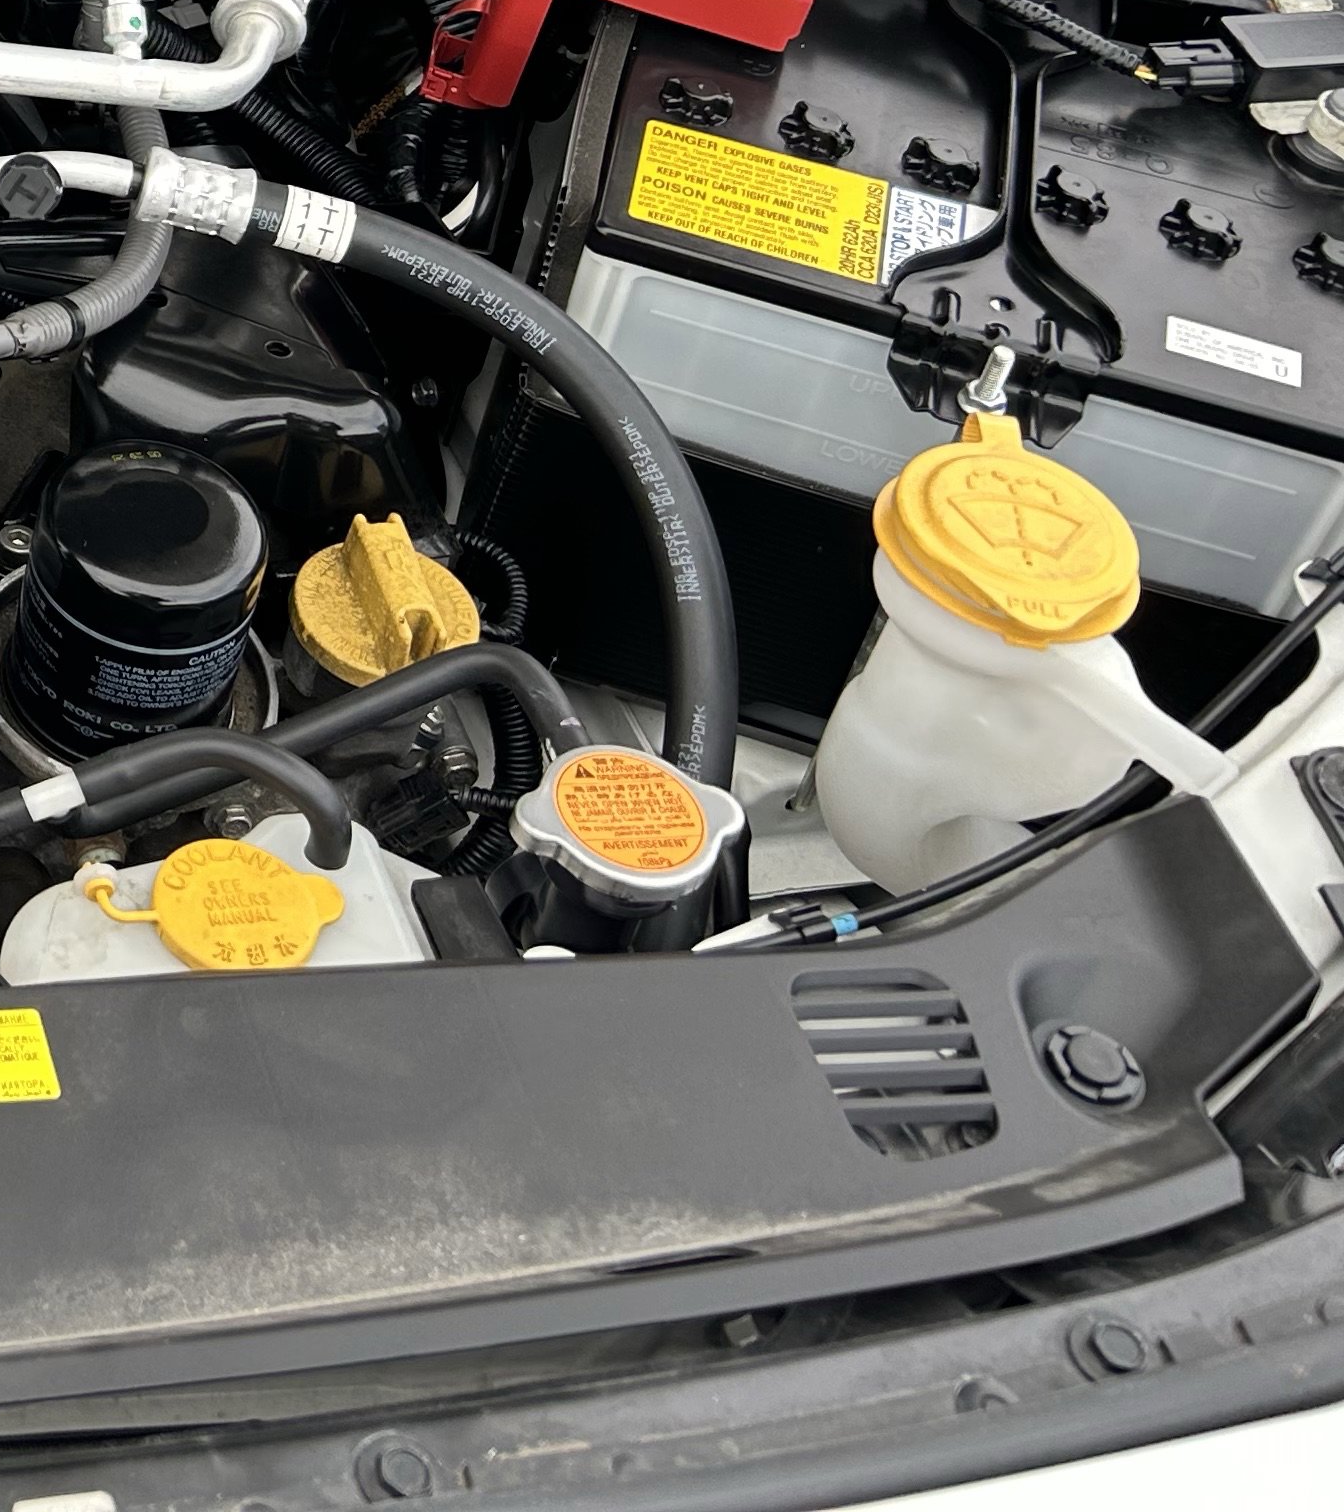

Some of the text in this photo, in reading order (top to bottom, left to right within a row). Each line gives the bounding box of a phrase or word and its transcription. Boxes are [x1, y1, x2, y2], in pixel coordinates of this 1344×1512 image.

[651, 125, 719, 151] DANGER
[722, 145, 776, 168] EXPLOSIVE
[778, 160, 812, 177] GASES
[640, 174, 707, 201] POISON
[711, 194, 752, 214] CAUSES
[753, 206, 792, 224] SEVERE
[793, 217, 829, 235] BURNS
[655, 165, 828, 220] KEEP VENT CAPS TIGHT AND LEVEL
[894, 191, 915, 226] START
[646, 209, 819, 264] KEEP OUT OF REACH OF CHILDREN
[861, 228, 879, 256] 620A
[889, 232, 911, 266] STOP
[856, 255, 875, 280] CCA
[1275, 364, 1289, 378] U
[188, 639, 237, 666] CAUTION
[62, 699, 102, 725] ROKI
[603, 838, 688, 850] AVERTISSEMENT
[163, 845, 291, 891] COOLANT
[208, 908, 277, 928] MANUAL
